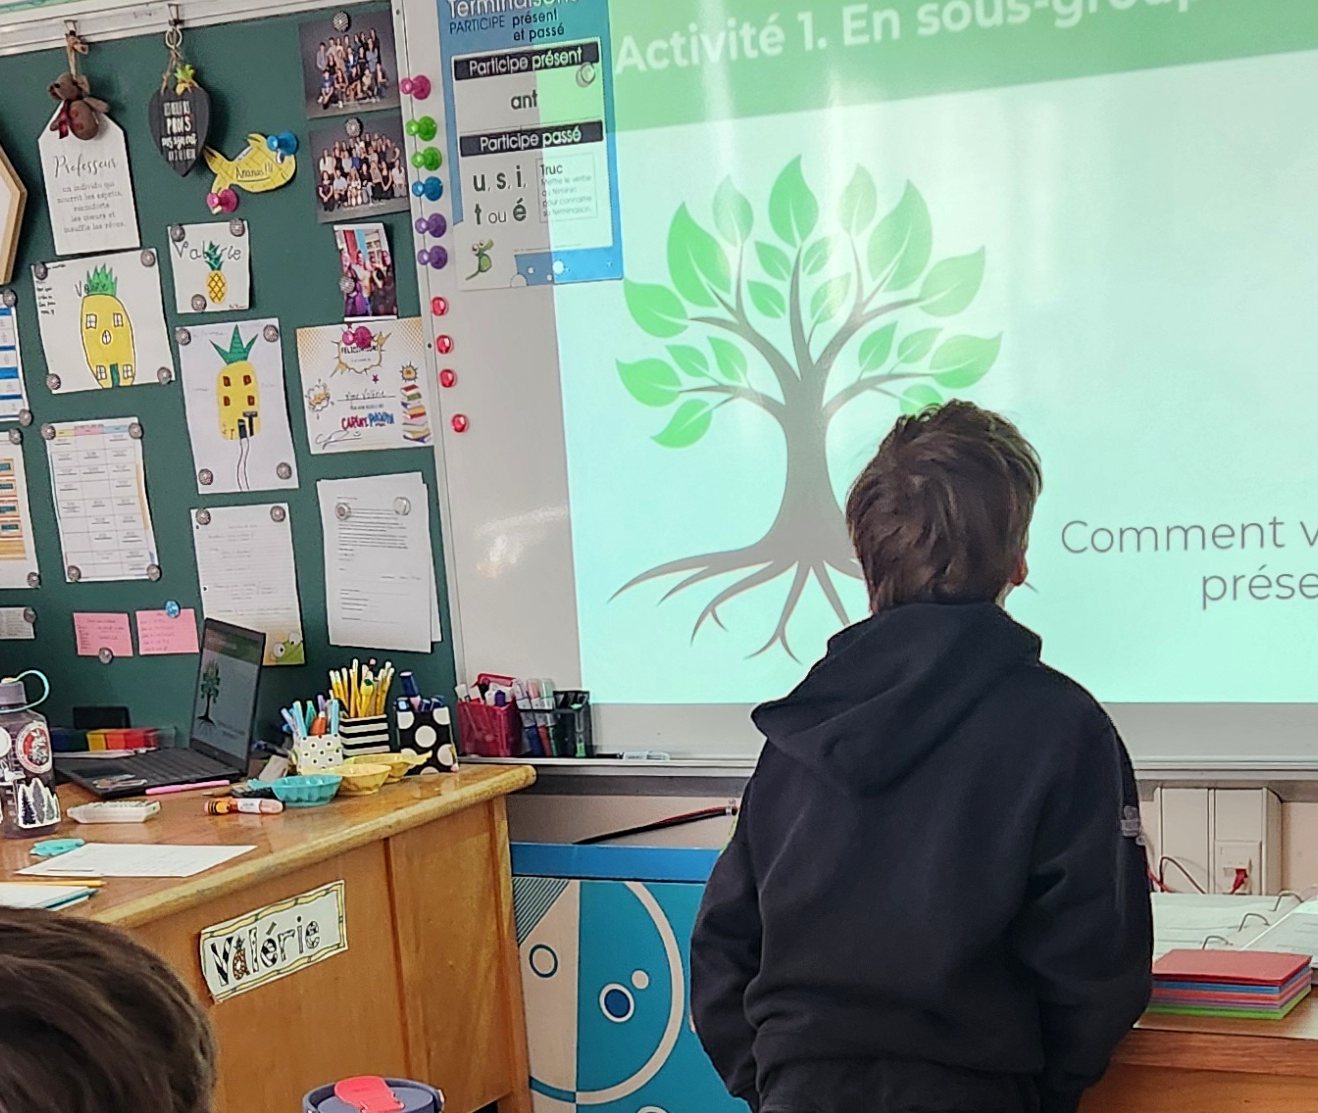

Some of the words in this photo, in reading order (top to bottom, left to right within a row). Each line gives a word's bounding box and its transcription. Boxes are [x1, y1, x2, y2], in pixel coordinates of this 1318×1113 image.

[449, 14, 506, 35] PARTICIPE
[512, 8, 558, 28] présent
[513, 29, 525, 41] et
[529, 23, 565, 42] passé
[614, 12, 785, 75] Activité
[802, 12, 828, 51] 1.
[841, 3, 901, 47] En
[469, 56, 529, 77] Participe
[532, 48, 583, 71] présent
[510, 90, 539, 110] ant
[480, 132, 539, 152] Participe
[542, 126, 582, 148] passé
[488, 211, 507, 225] ou
[513, 197, 527, 222] é
[172, 240, 242, 261] Valrie
[1060, 514, 1287, 555] Comment
[210, 915, 321, 987] Valérie
